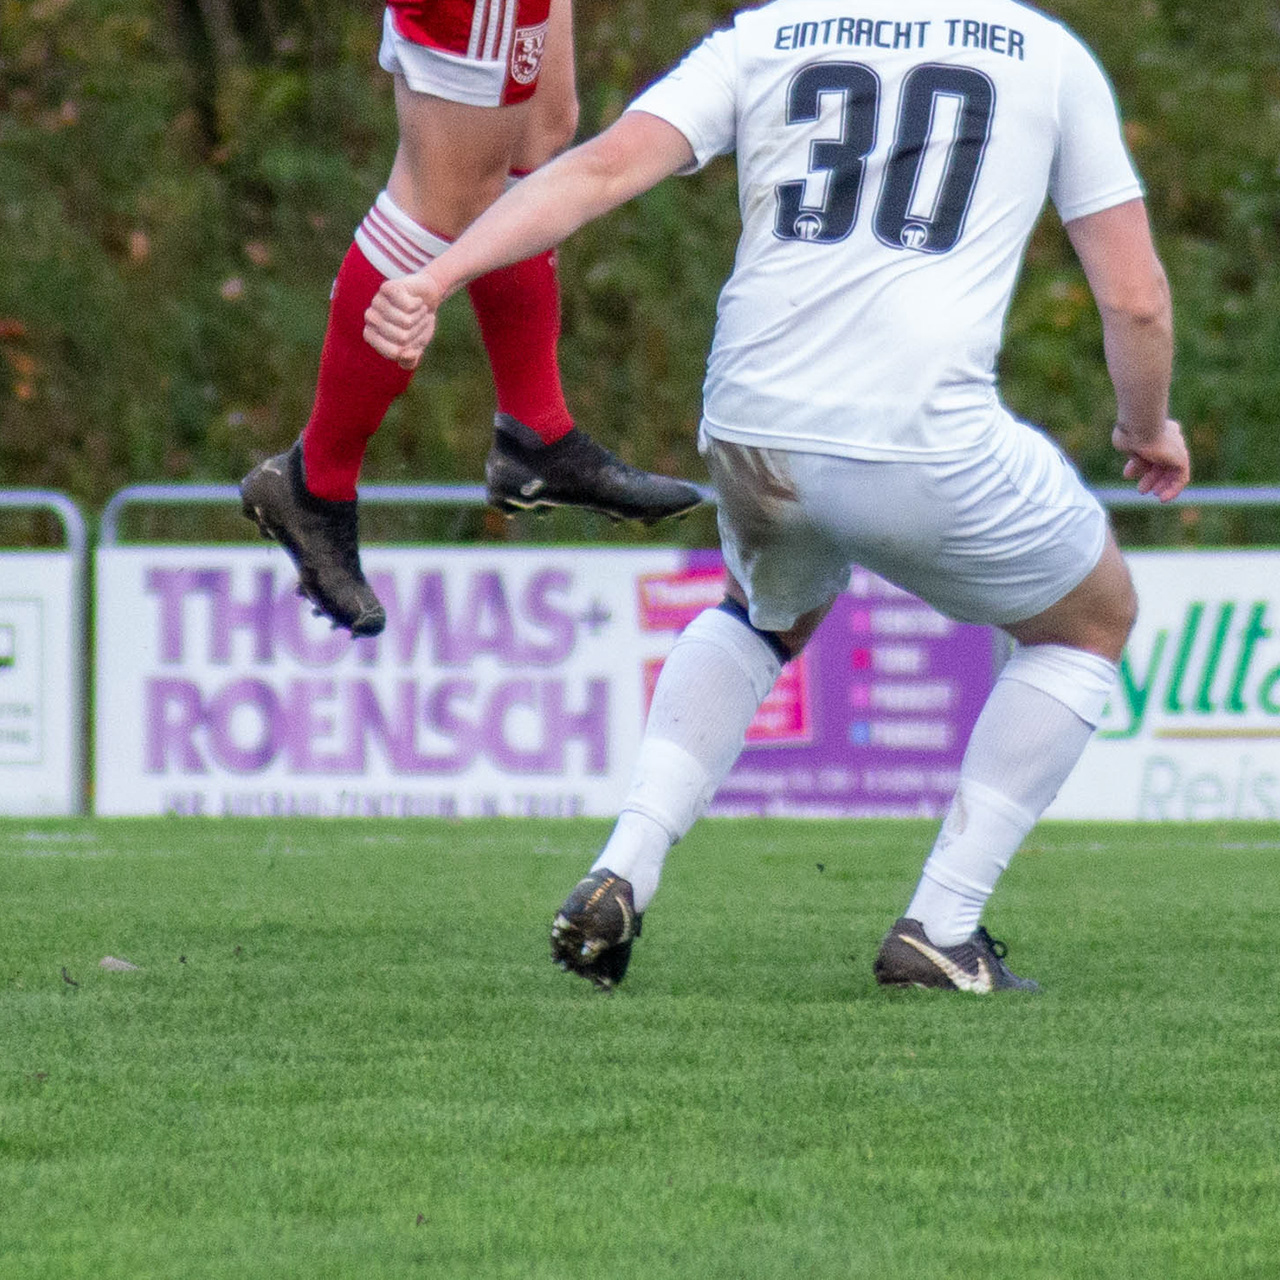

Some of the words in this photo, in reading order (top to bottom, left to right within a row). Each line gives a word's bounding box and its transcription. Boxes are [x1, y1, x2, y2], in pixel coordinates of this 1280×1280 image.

[774, 17, 931, 50] EINTRACHT
[945, 19, 1025, 61] TRIER
[772, 60, 996, 254] 30
[144, 677, 612, 774] ROENSCH
